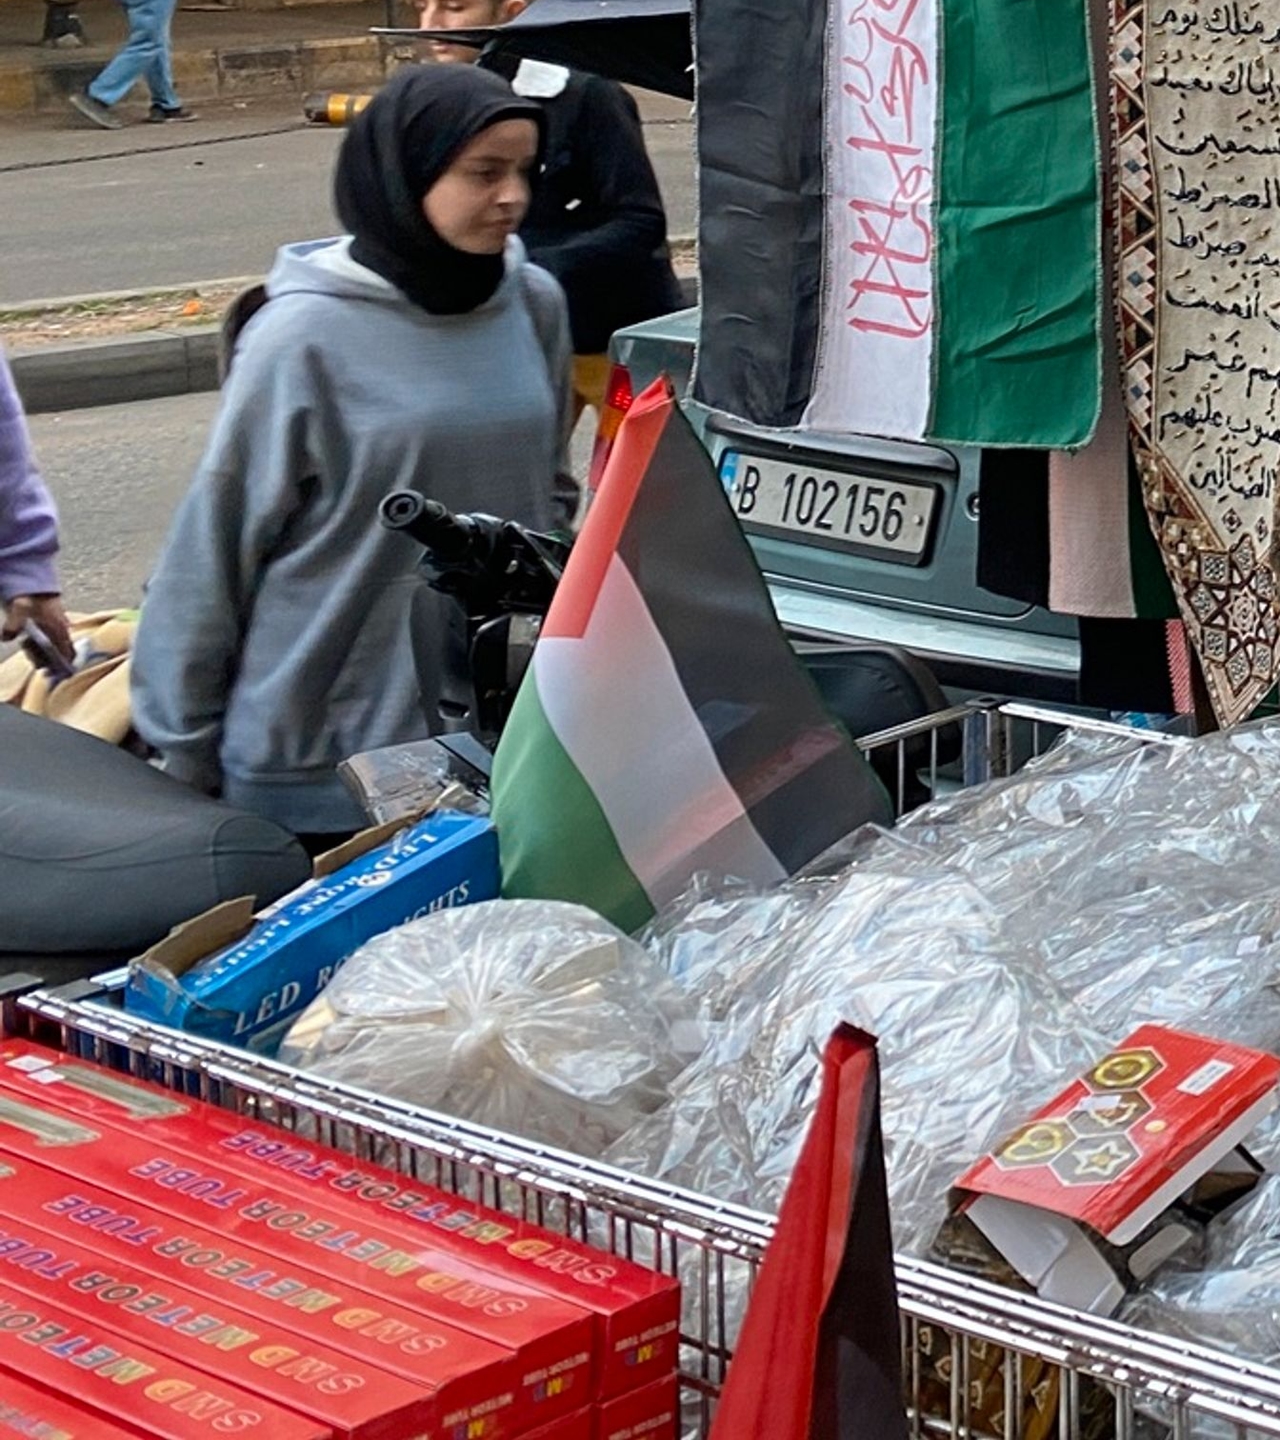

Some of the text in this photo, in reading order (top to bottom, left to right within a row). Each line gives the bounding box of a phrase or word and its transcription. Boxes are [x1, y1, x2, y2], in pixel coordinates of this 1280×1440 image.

[738, 464, 907, 542] B 102156
[232, 980, 300, 1036] LED
[129, 1158, 528, 1317] SMD METEOR TUBE
[219, 1130, 617, 1285] SMD METEOR TUBE
[42, 1194, 447, 1355] SMD METEOR TUBE
[69, 1271, 259, 1351] METEOR
[0, 1302, 156, 1385] METEO
[249, 1345, 365, 1395] SMD
[144, 1379, 261, 1432] SMD
